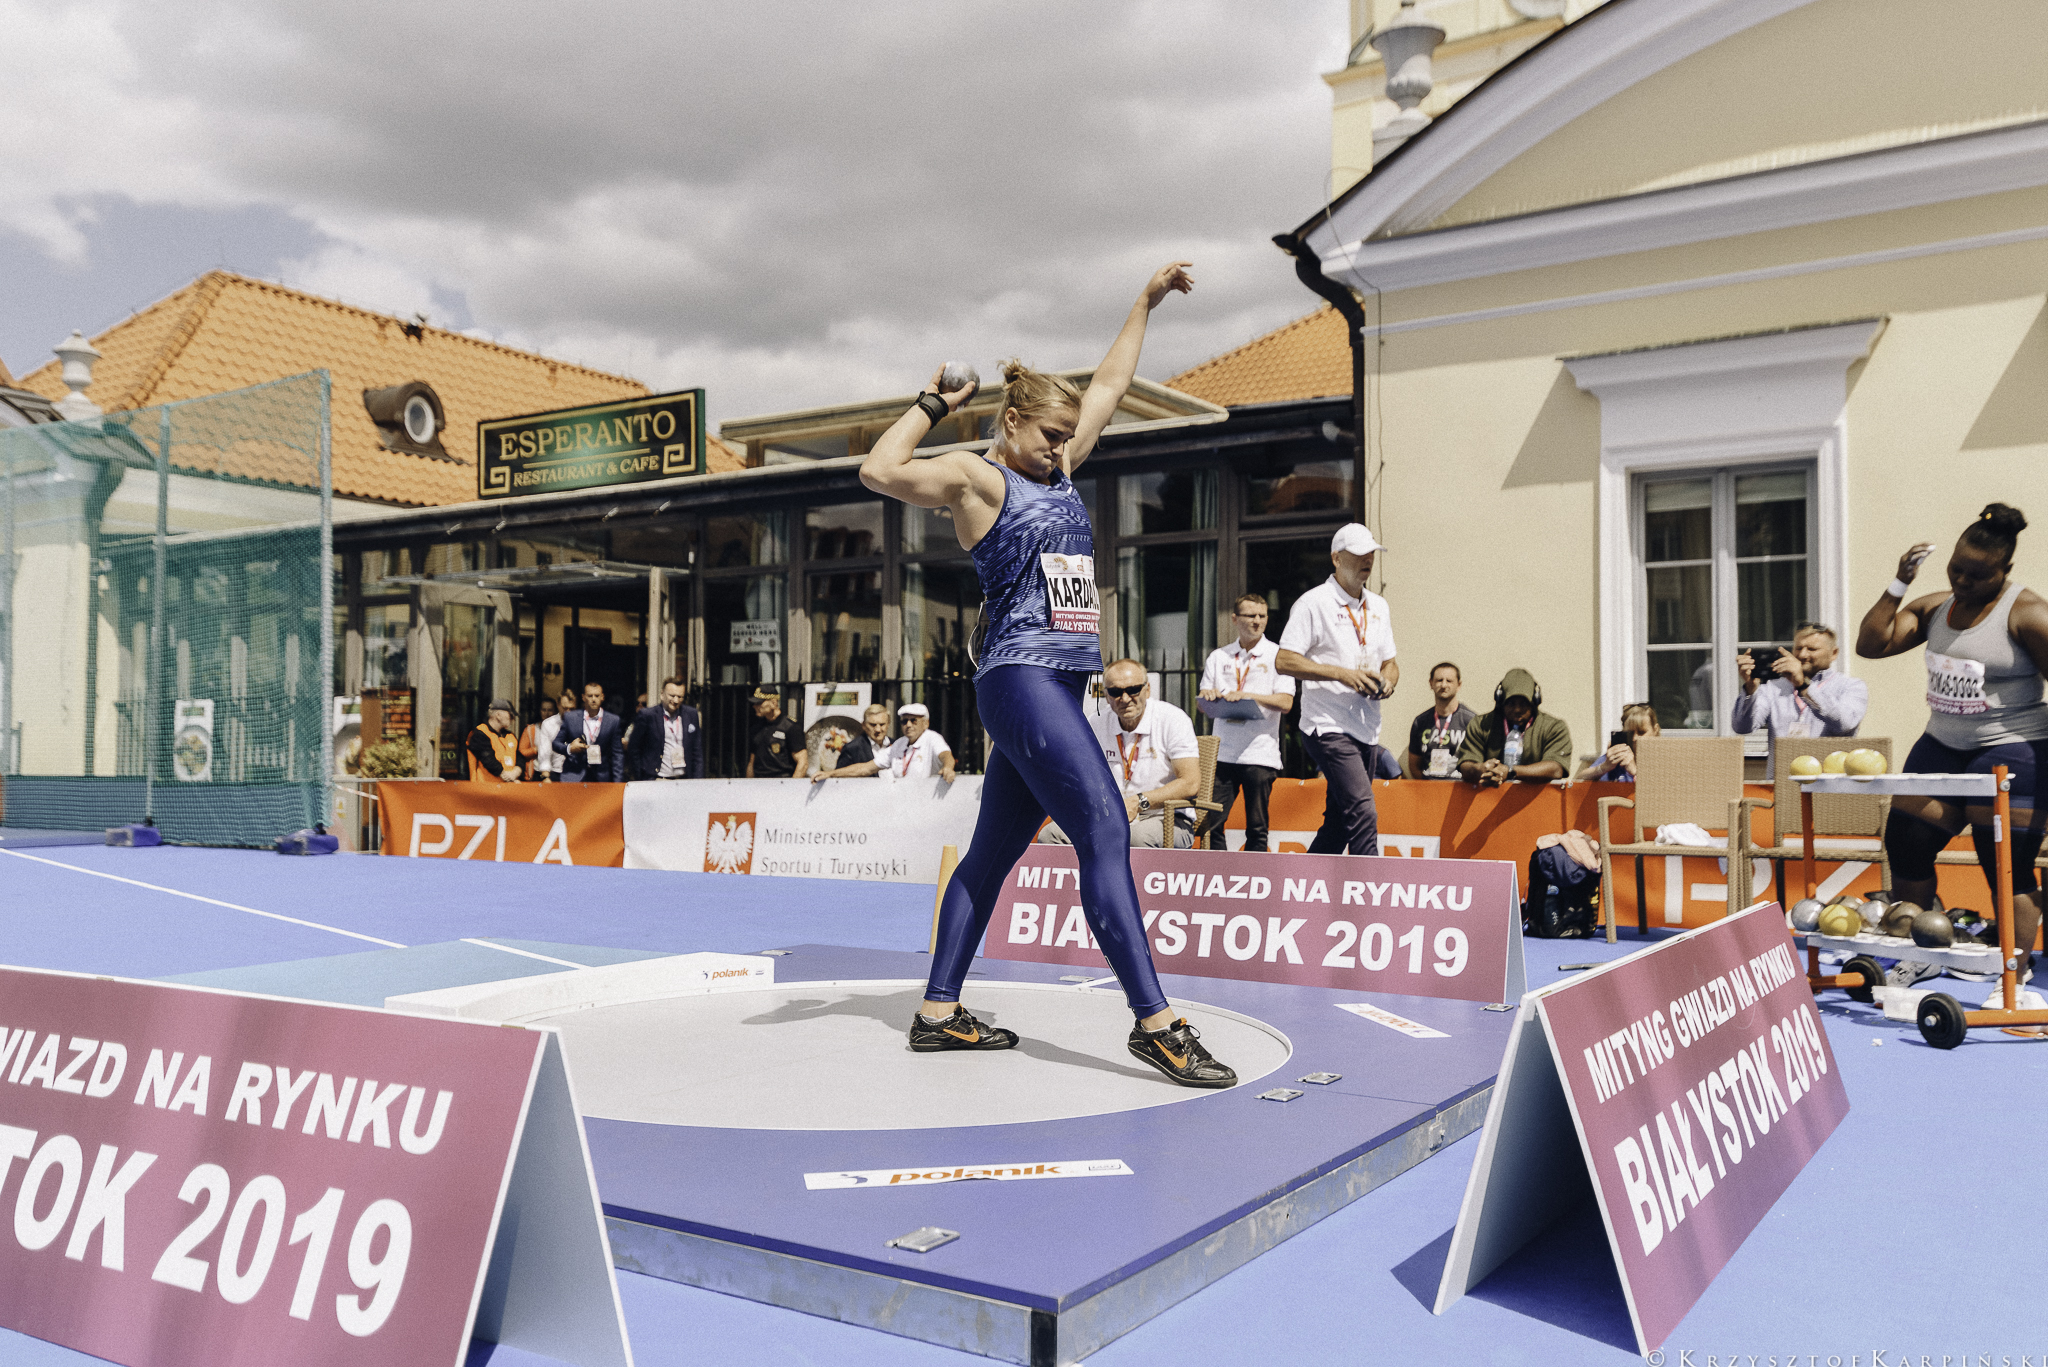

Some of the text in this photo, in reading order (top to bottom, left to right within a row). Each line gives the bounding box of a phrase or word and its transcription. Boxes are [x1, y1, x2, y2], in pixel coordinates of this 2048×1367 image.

[499, 410, 676, 460] ESPERANTO
[513, 455, 660, 487] RESTAURANT & CAFE
[1053, 620, 1095, 631] BIAŁYSTOK
[763, 828, 868, 845] Ministerstwo
[760, 857, 907, 880] Sportu i Turystyki
[1143, 871, 1272, 900] GWIAZD
[1282, 878, 1330, 904] NA
[1341, 880, 1473, 912] RYNKU
[1321, 920, 1470, 978] 2019
[711, 967, 749, 981] polanik
[1583, 942, 1796, 1104] MITYNG GWIAZD NA RYNKU
[134, 1048, 212, 1116] NA
[224, 1061, 454, 1155] RYNKU
[1613, 1003, 1828, 1257] BIAŁYSTOK 2019
[889, 1164, 1062, 1185] polanik
[151, 1163, 413, 1337] 2019
